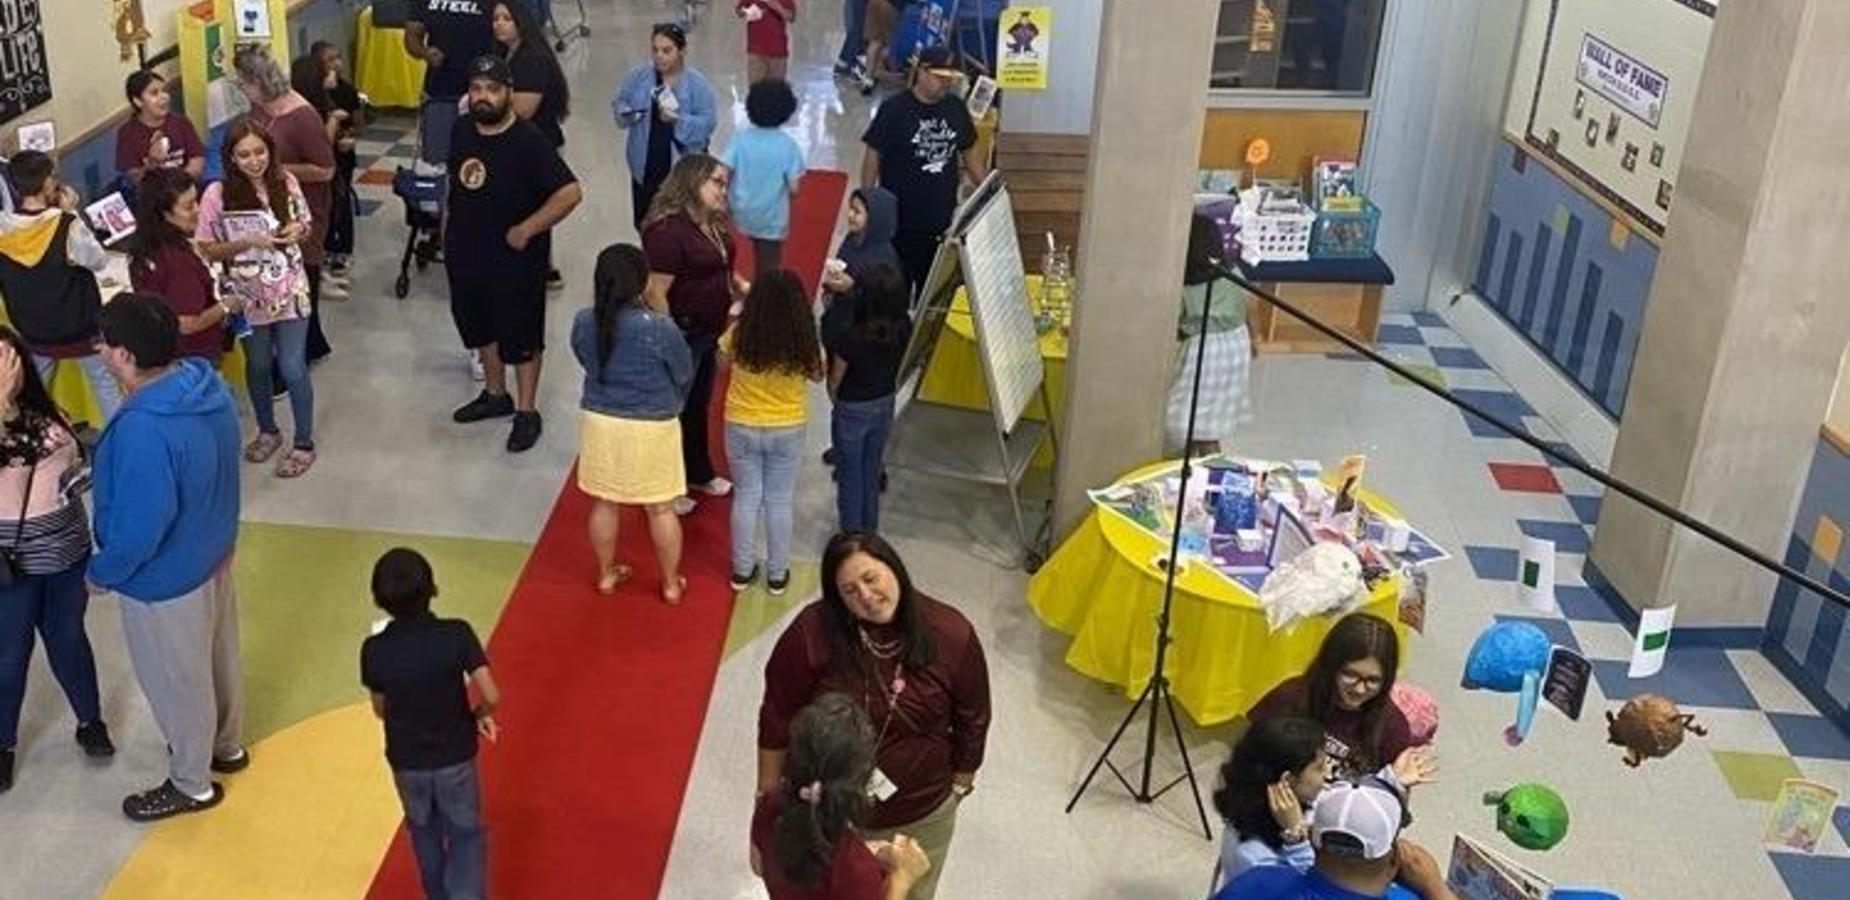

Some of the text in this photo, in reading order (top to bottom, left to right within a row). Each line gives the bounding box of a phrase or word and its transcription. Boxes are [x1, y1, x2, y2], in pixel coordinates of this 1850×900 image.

[428, 0, 482, 15] STEEL
[1586, 41, 1612, 70] WALL
[1615, 58, 1630, 78] OF
[1630, 66, 1662, 98] FAME
